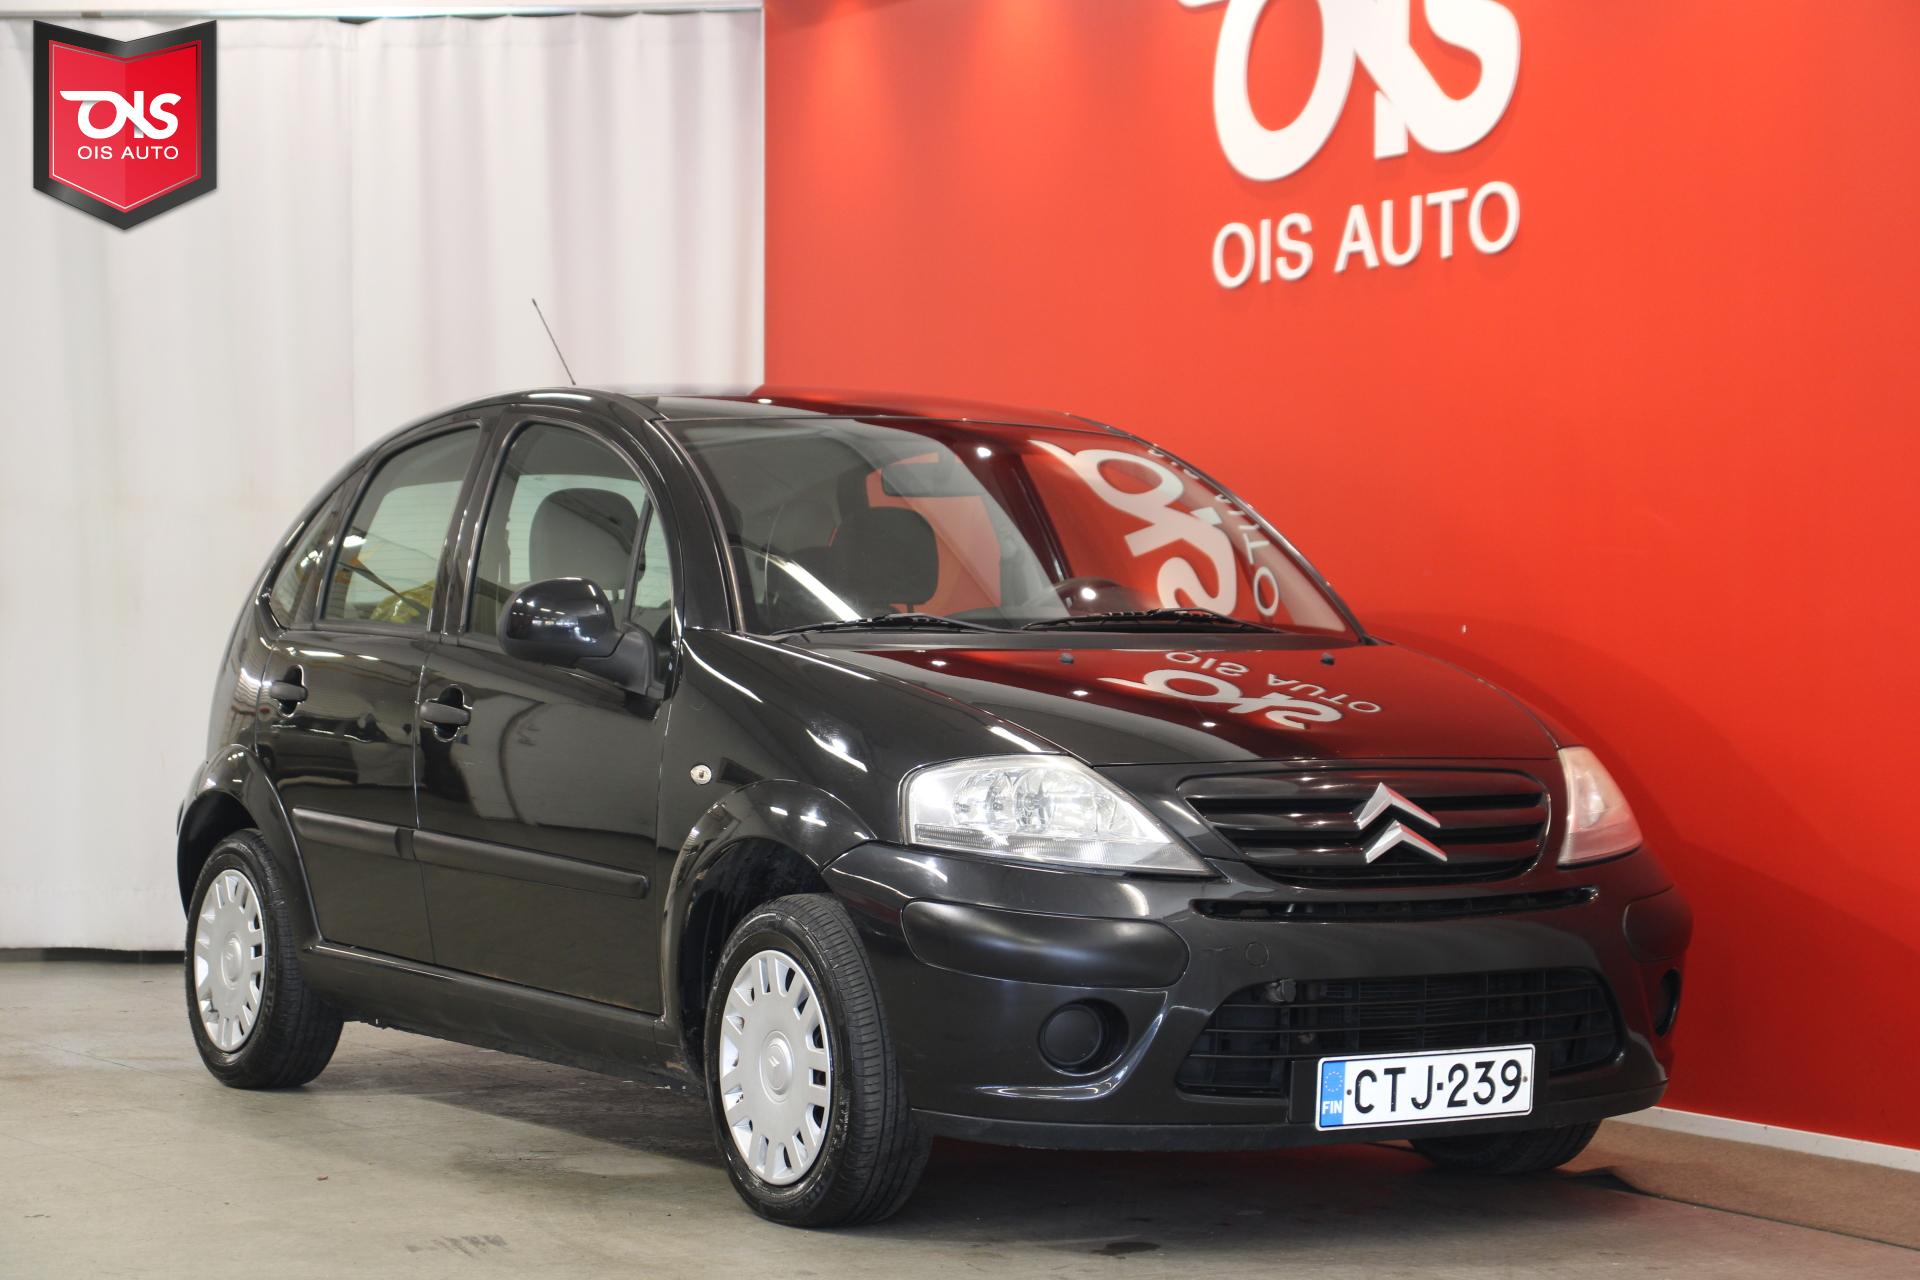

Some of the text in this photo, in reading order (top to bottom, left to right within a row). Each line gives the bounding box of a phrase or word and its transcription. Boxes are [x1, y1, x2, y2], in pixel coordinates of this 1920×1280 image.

[1212, 181, 1520, 289] OIS AUTO
[1322, 1100, 1343, 1115] FIN
[1354, 1059, 1523, 1114] CTJ-239
